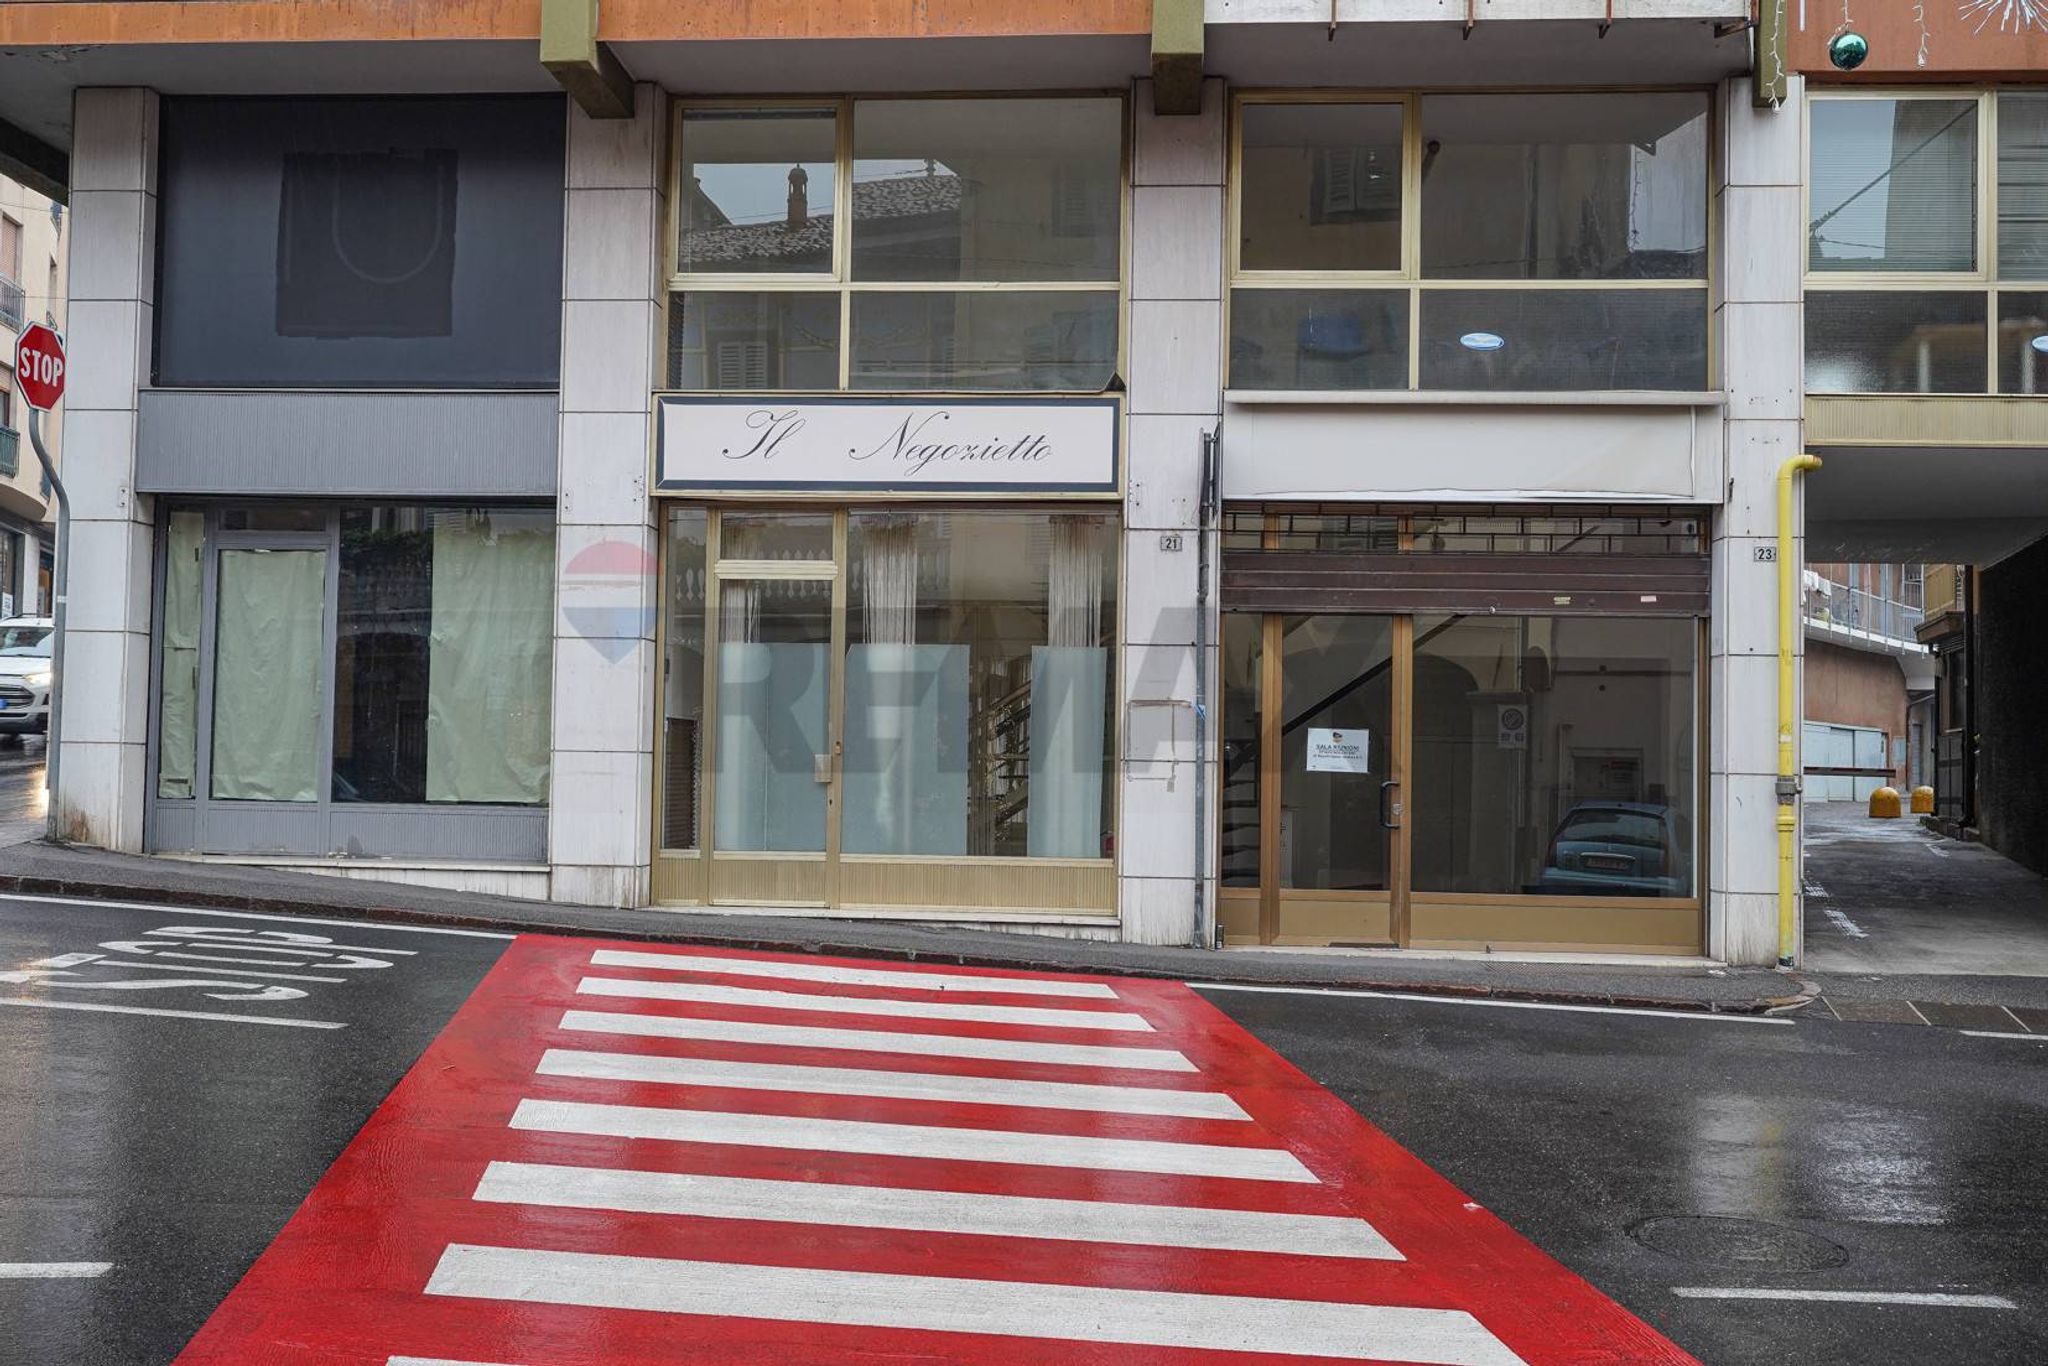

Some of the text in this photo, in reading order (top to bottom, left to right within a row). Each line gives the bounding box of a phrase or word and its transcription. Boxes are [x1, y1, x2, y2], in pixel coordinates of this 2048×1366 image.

[20, 347, 63, 387] STOP
[722, 409, 1053, 477] Il Negozietto
[1166, 538, 1177, 549] 21
[1758, 548, 1772, 560] 23
